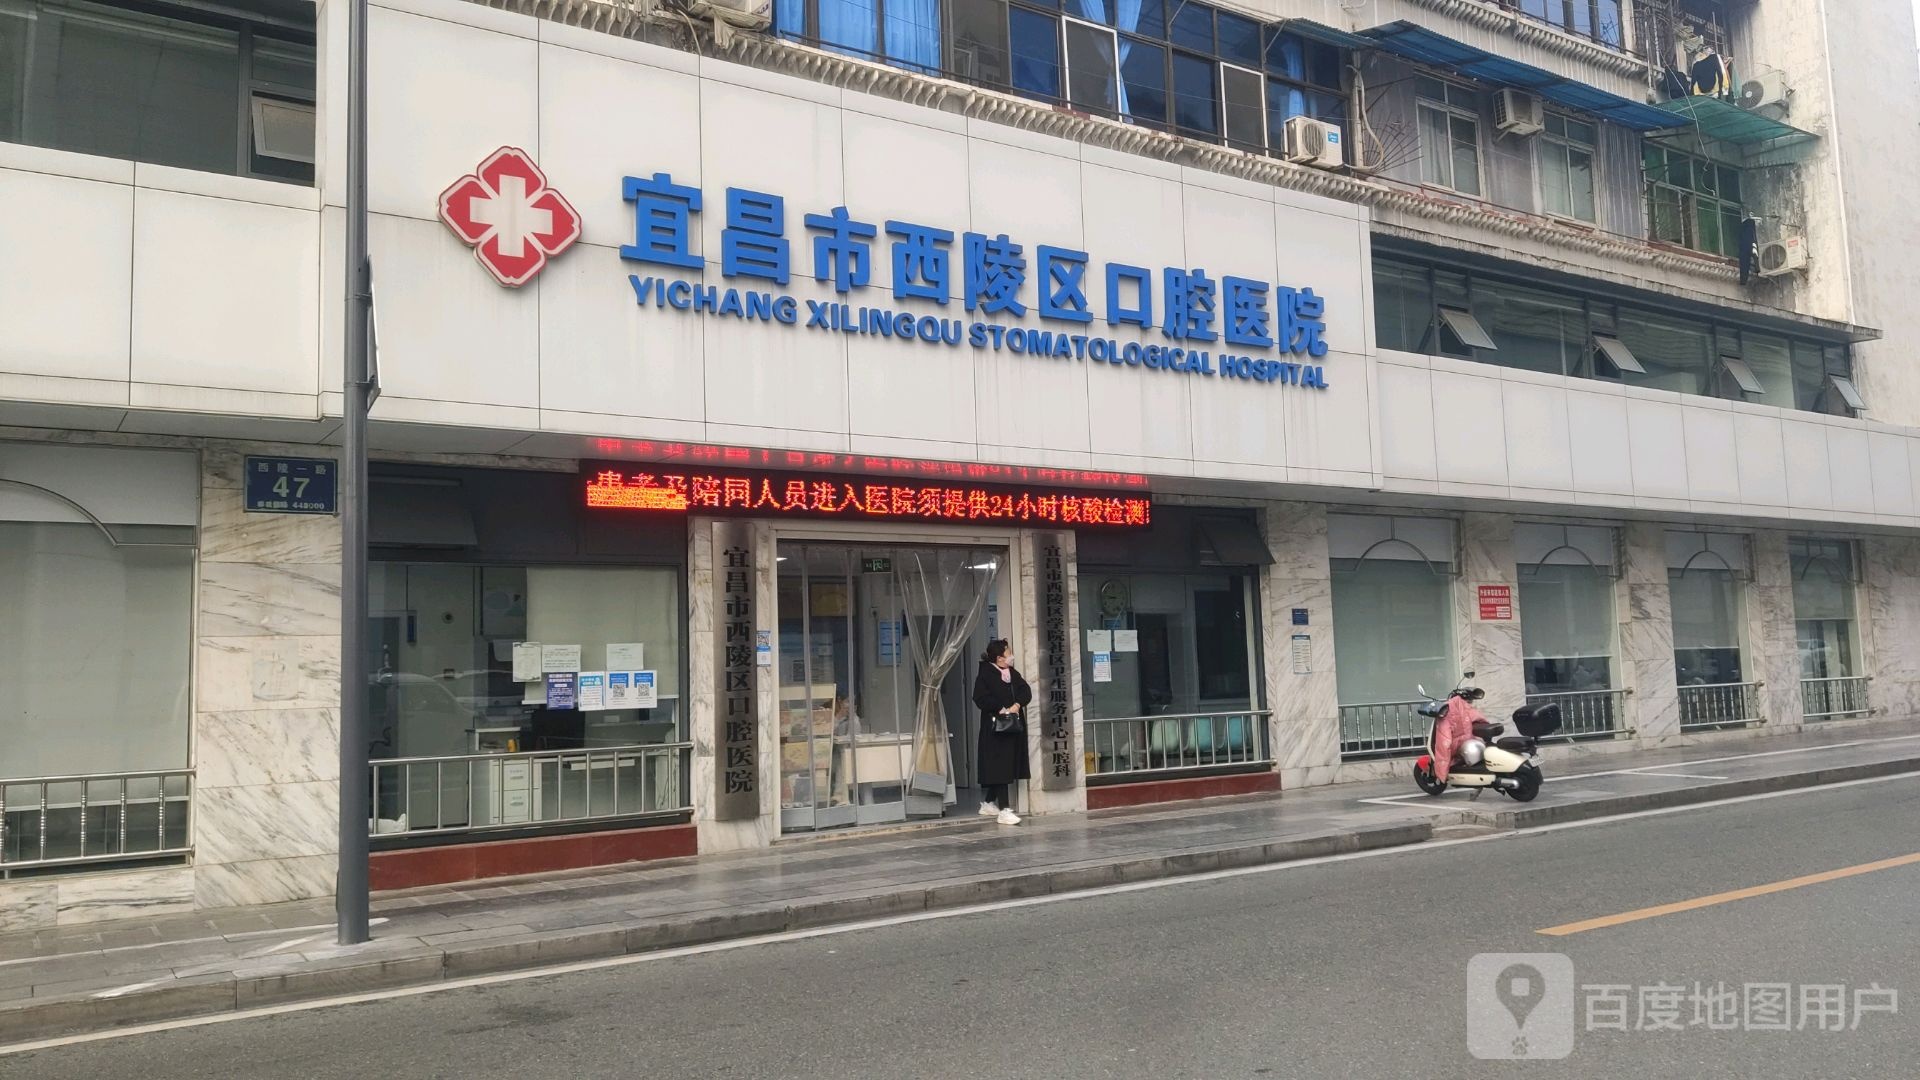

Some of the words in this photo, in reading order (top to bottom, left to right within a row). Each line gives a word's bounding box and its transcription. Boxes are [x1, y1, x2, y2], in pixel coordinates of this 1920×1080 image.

[620, 172, 1328, 357] 宜昌市西陵区口腔医院
[628, 275, 797, 323] YICHANG
[806, 300, 963, 345] XILINGQU
[968, 322, 1216, 376] STOMATOLOGICAL
[1219, 353, 1329, 389] HOSPITAL
[272, 476, 310, 498] 47
[723, 546, 753, 795] 宜昌市西陵区口腔医院
[1044, 544, 1071, 778] 宜昌市西陵区学院社区卫生服务中心口腔科
